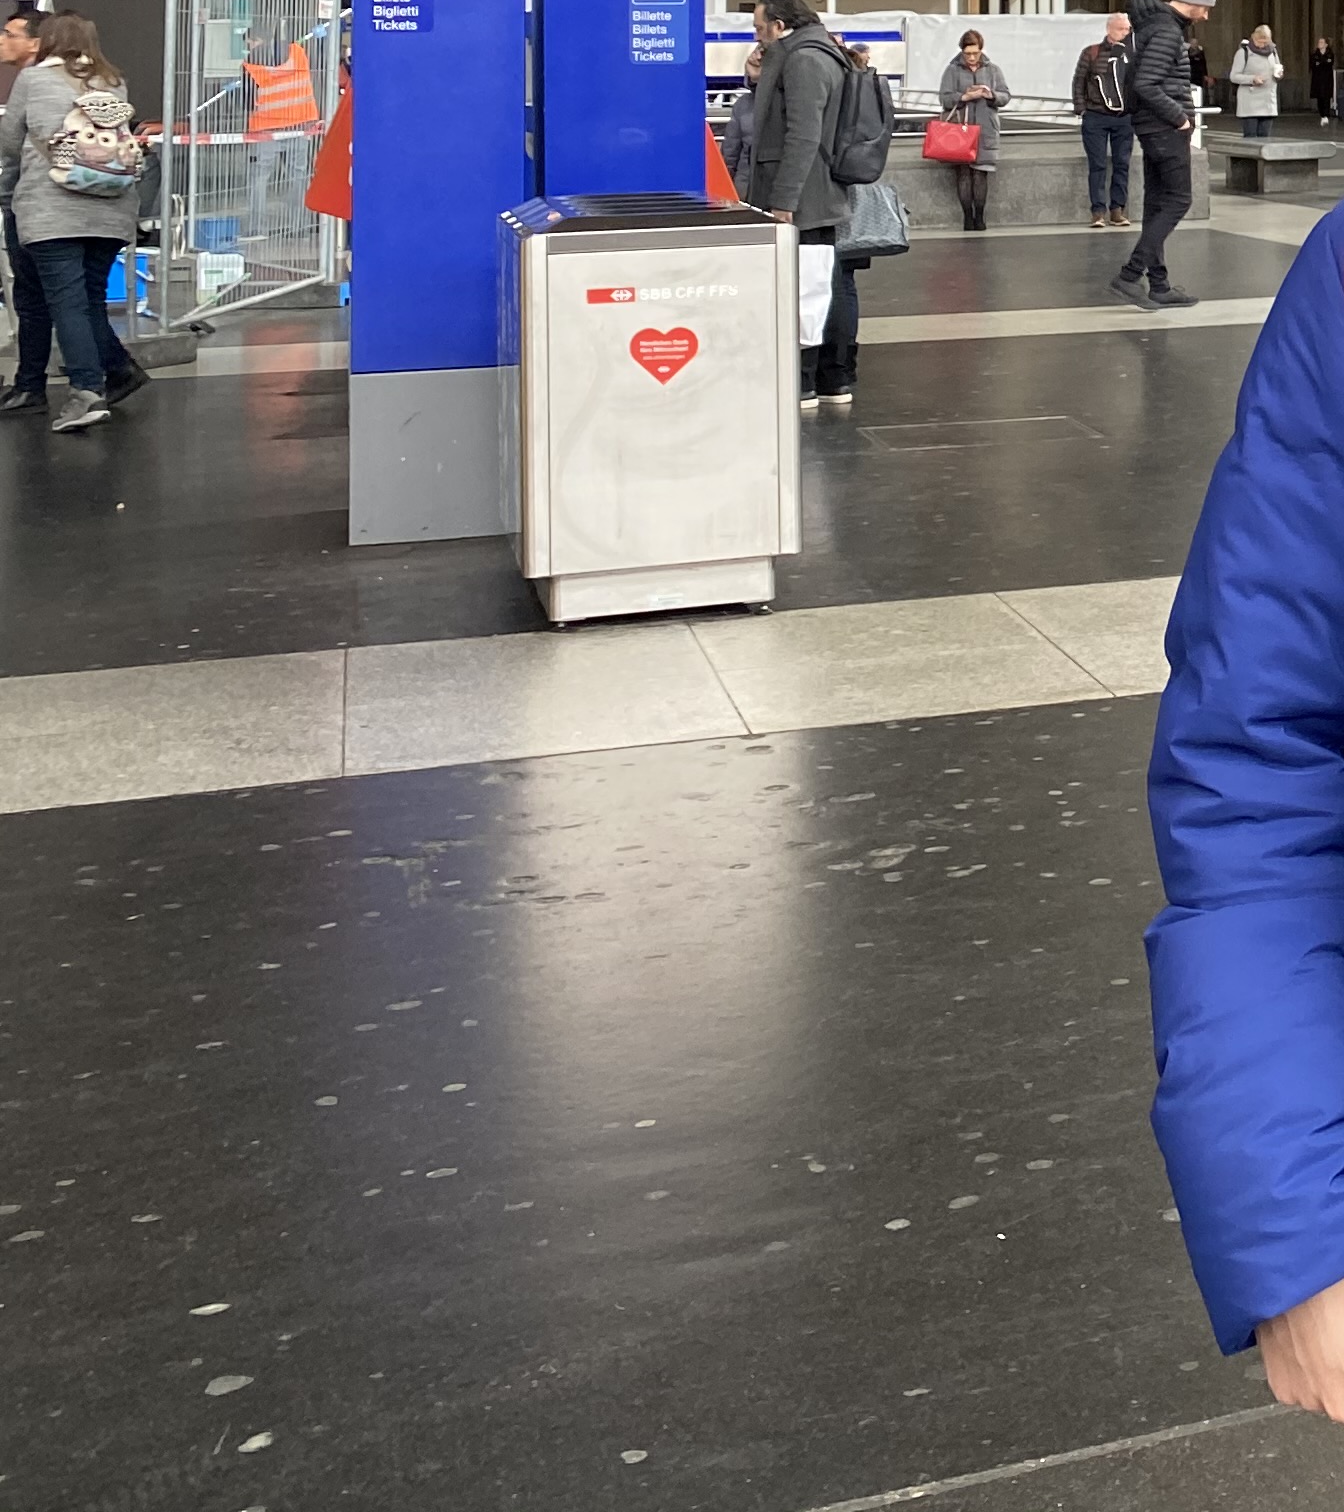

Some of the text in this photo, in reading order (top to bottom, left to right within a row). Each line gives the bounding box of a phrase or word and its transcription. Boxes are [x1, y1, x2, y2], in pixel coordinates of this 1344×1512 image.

[373, 5, 419, 18] Biglietti
[632, 10, 672, 21] Billette
[372, 19, 418, 30] Tickets
[632, 24, 667, 35] Billets
[632, 37, 675, 50] Biglietti
[632, 51, 674, 61] Tickets
[639, 284, 739, 301] SBB CFF FFS
